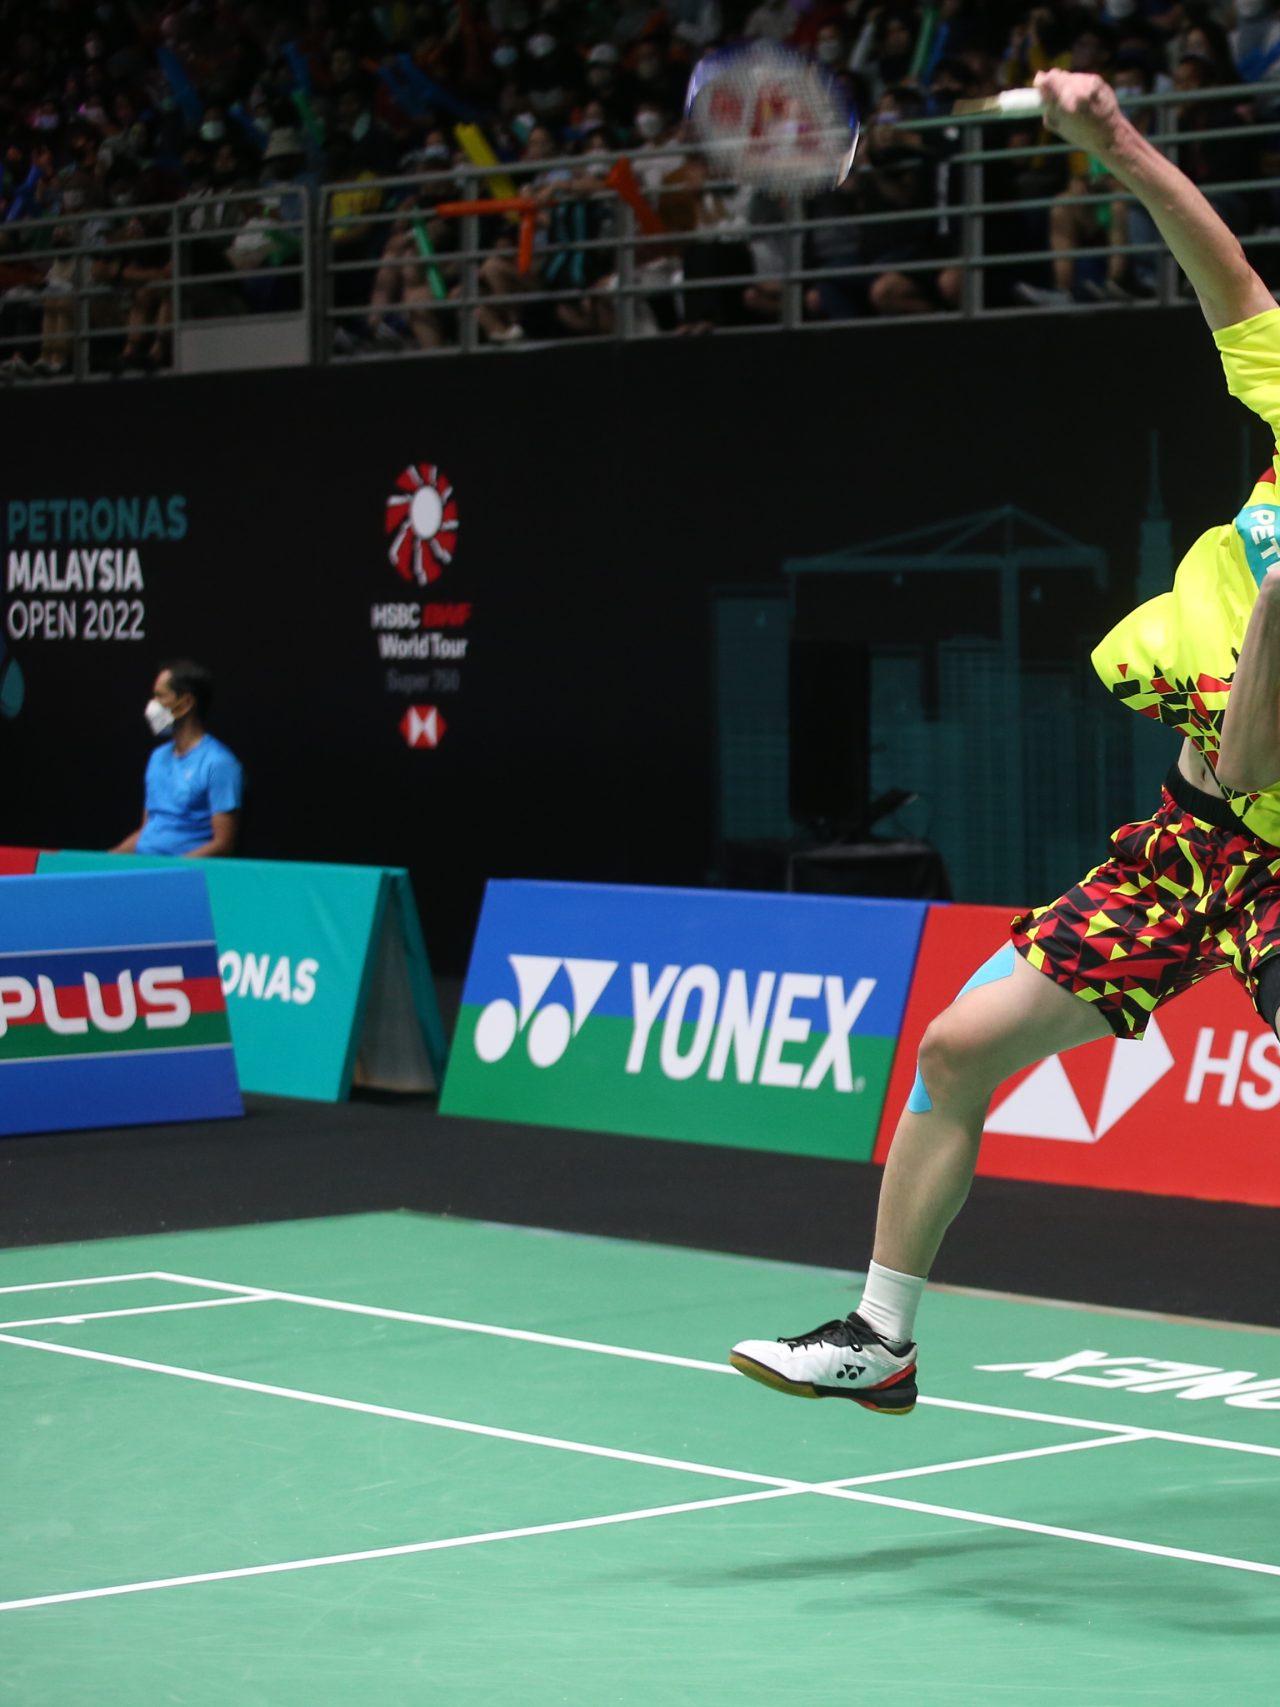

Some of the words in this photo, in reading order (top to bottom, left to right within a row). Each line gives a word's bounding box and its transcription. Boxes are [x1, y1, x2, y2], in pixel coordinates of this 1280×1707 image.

[7, 495, 188, 542] PETRONAS
[7, 548, 144, 592] MALAYSIA
[8, 600, 77, 640] OPEN
[83, 600, 145, 640] 2022
[371, 602, 421, 630] HSBC
[379, 633, 430, 659] World
[431, 633, 468, 659] Tour
[0, 965, 191, 1039] PLUS
[625, 962, 877, 1093] YONEX
